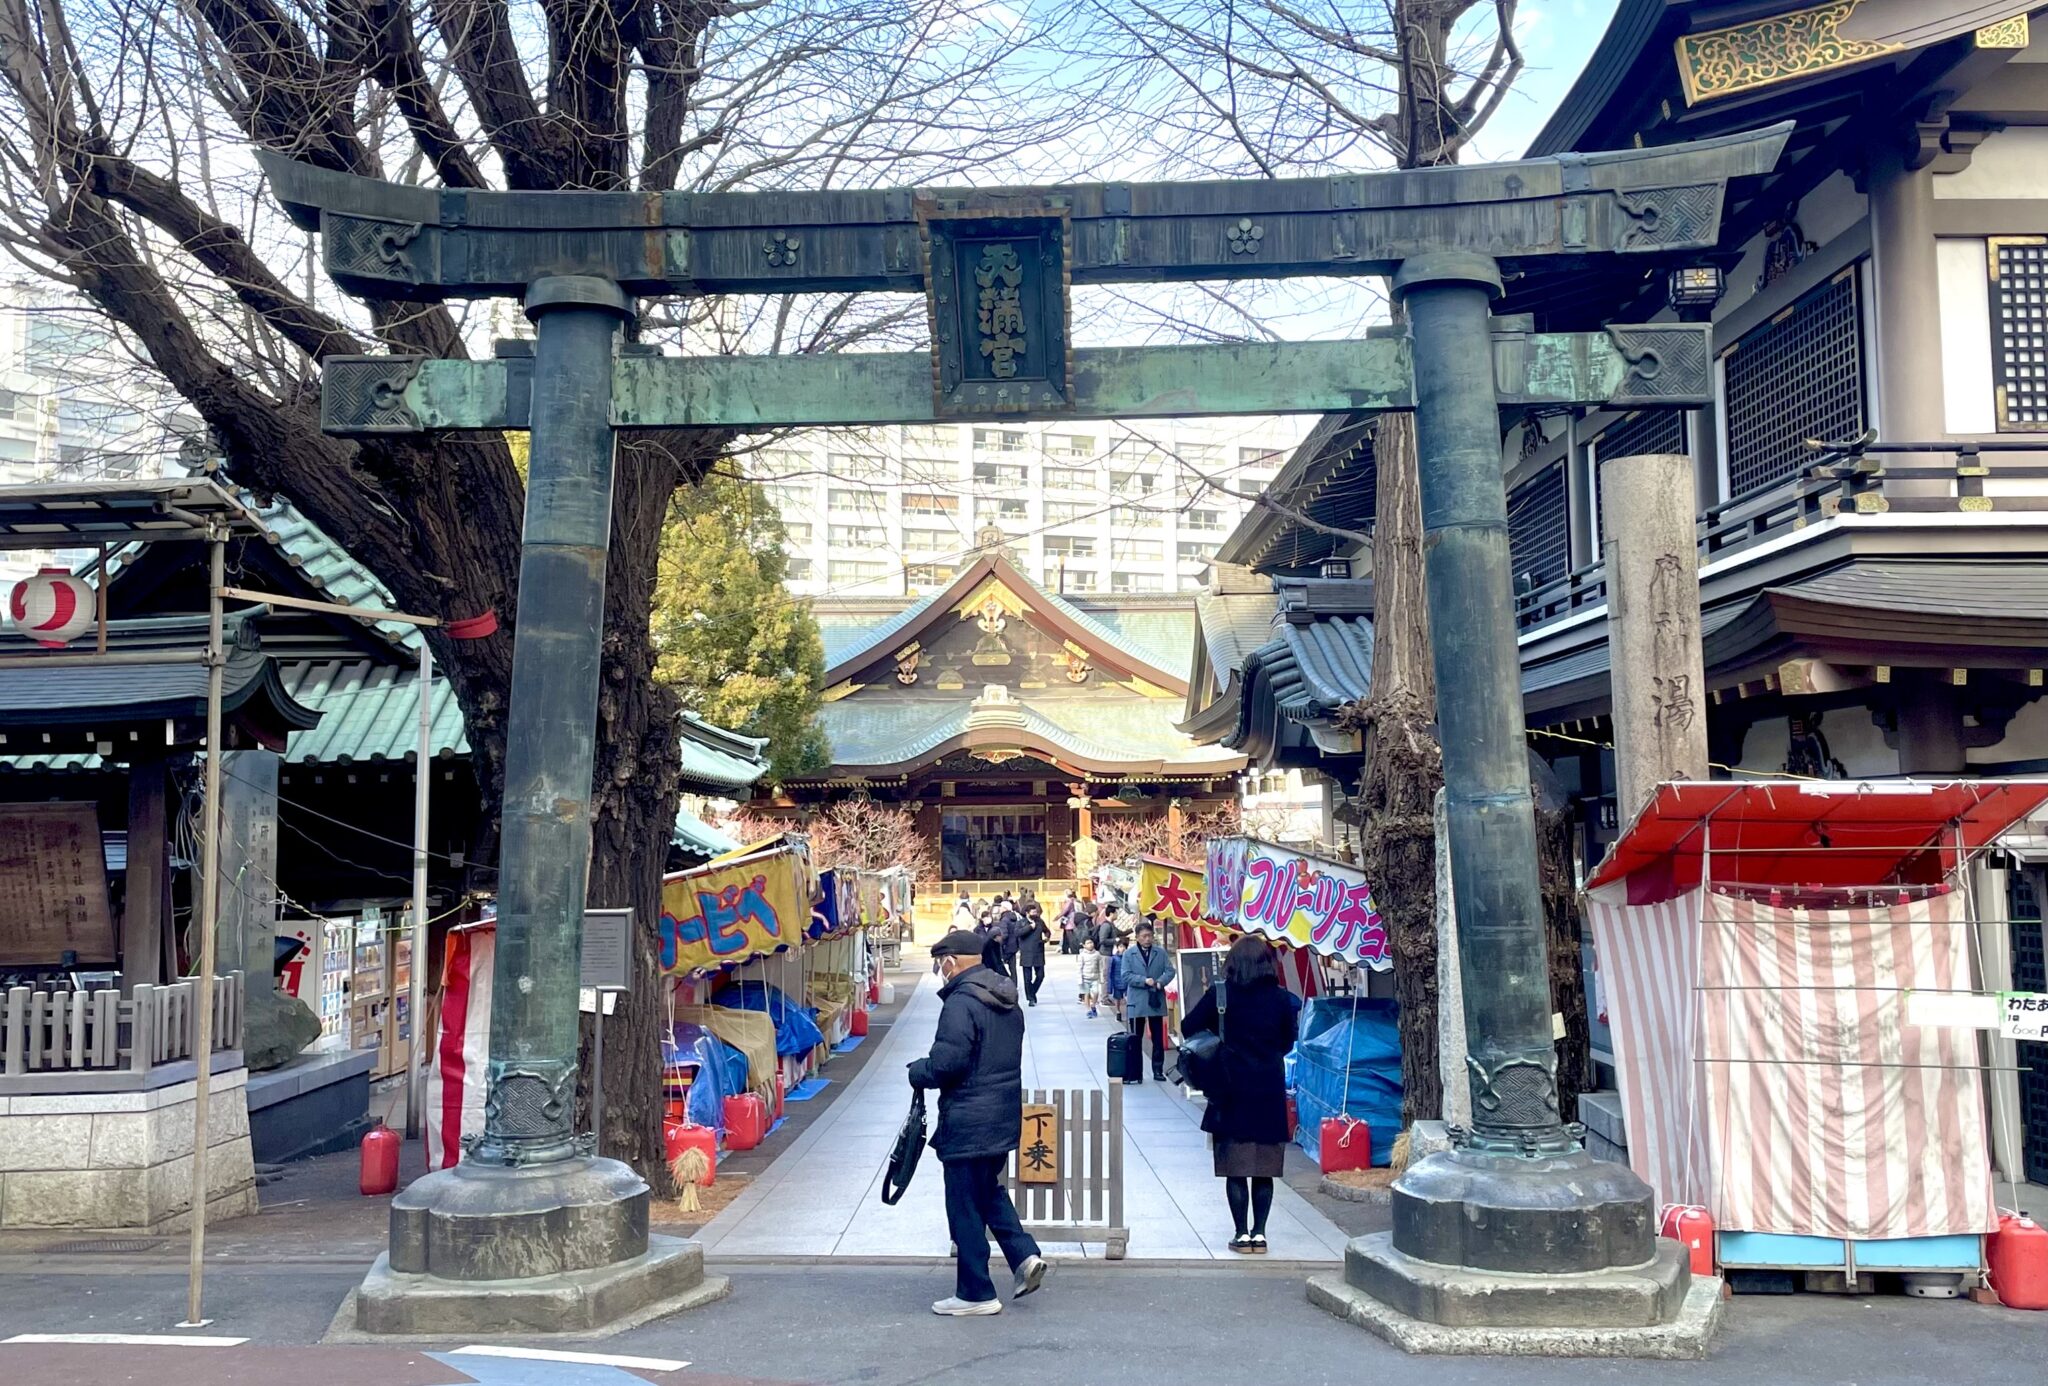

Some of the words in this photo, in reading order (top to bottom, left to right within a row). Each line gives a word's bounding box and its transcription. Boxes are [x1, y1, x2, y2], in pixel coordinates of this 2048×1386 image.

[1649, 552, 1697, 783] 府社湯
[1245, 857, 1393, 960] フルーツチョ
[1022, 1112, 1055, 1172] 下乗
